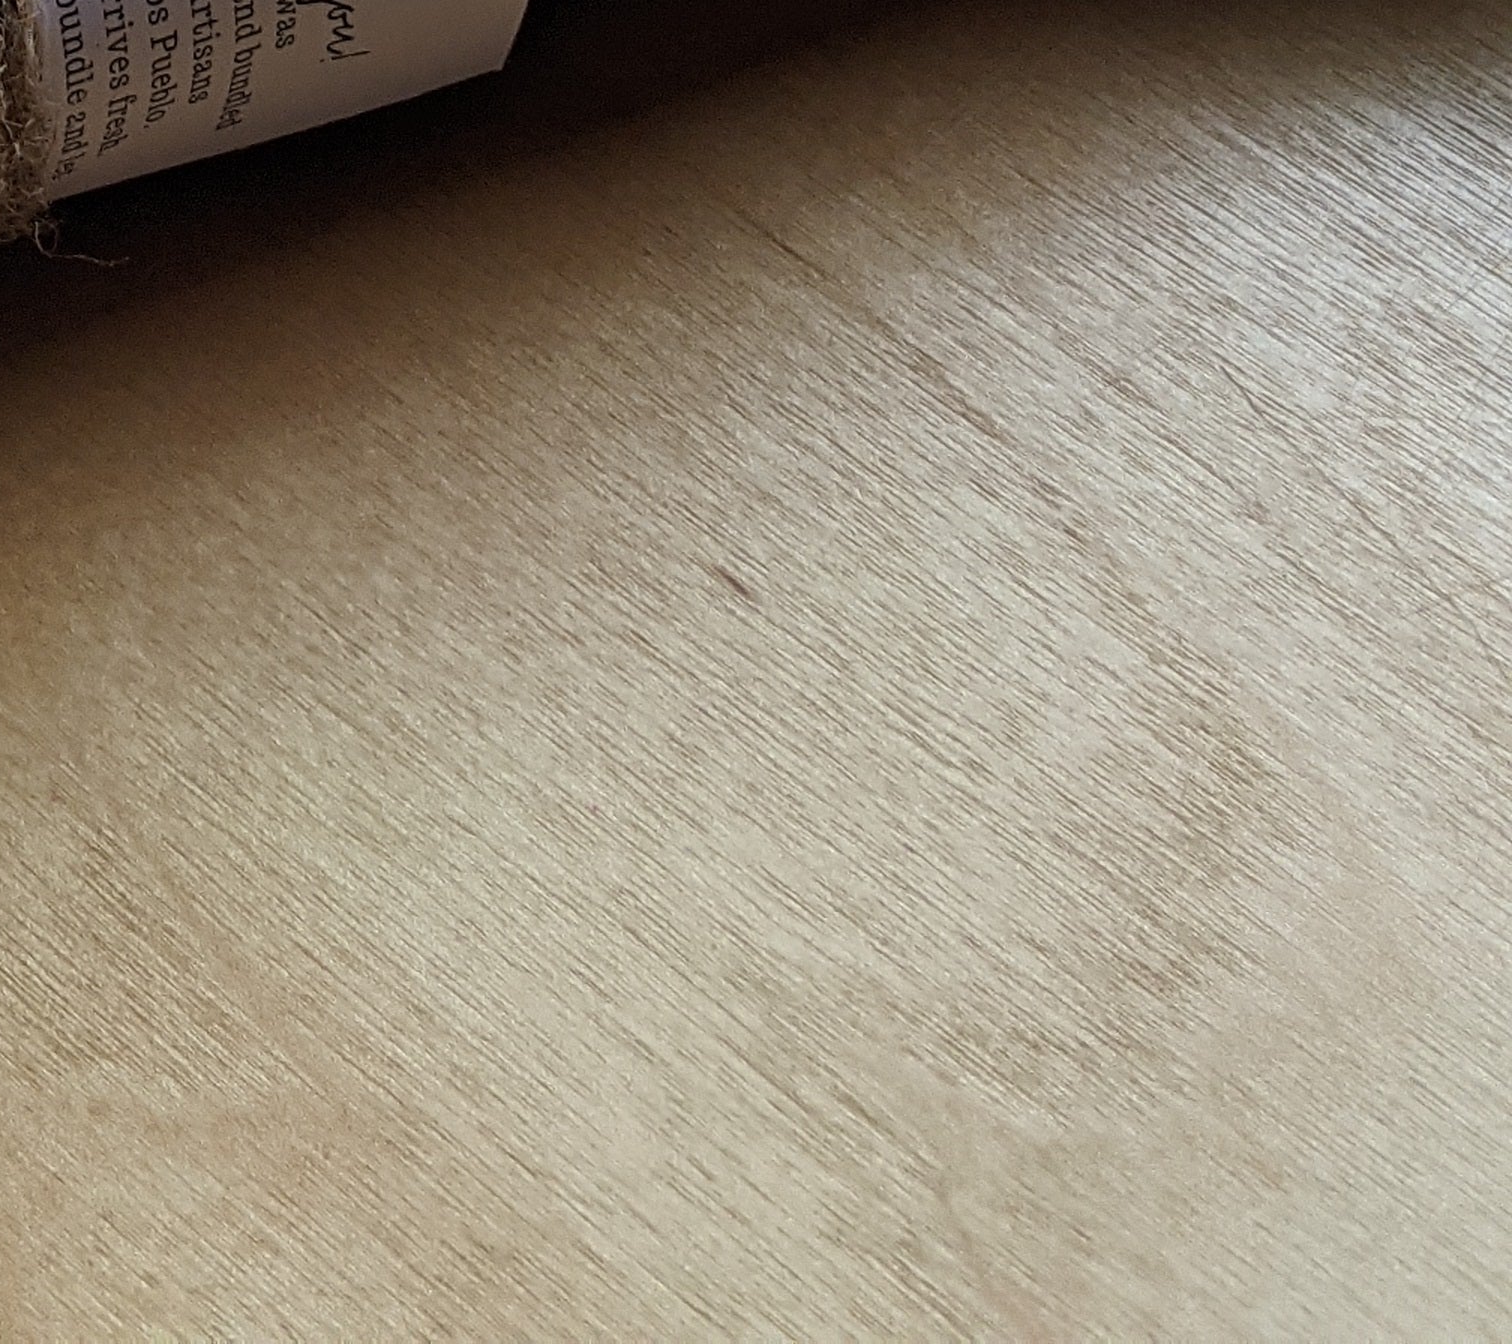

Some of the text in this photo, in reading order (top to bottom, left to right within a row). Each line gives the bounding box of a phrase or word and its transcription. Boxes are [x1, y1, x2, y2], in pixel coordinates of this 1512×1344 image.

[145, 29, 181, 130] Pueblo.
[215, 45, 255, 132] bundled
[62, 112, 88, 153] and
